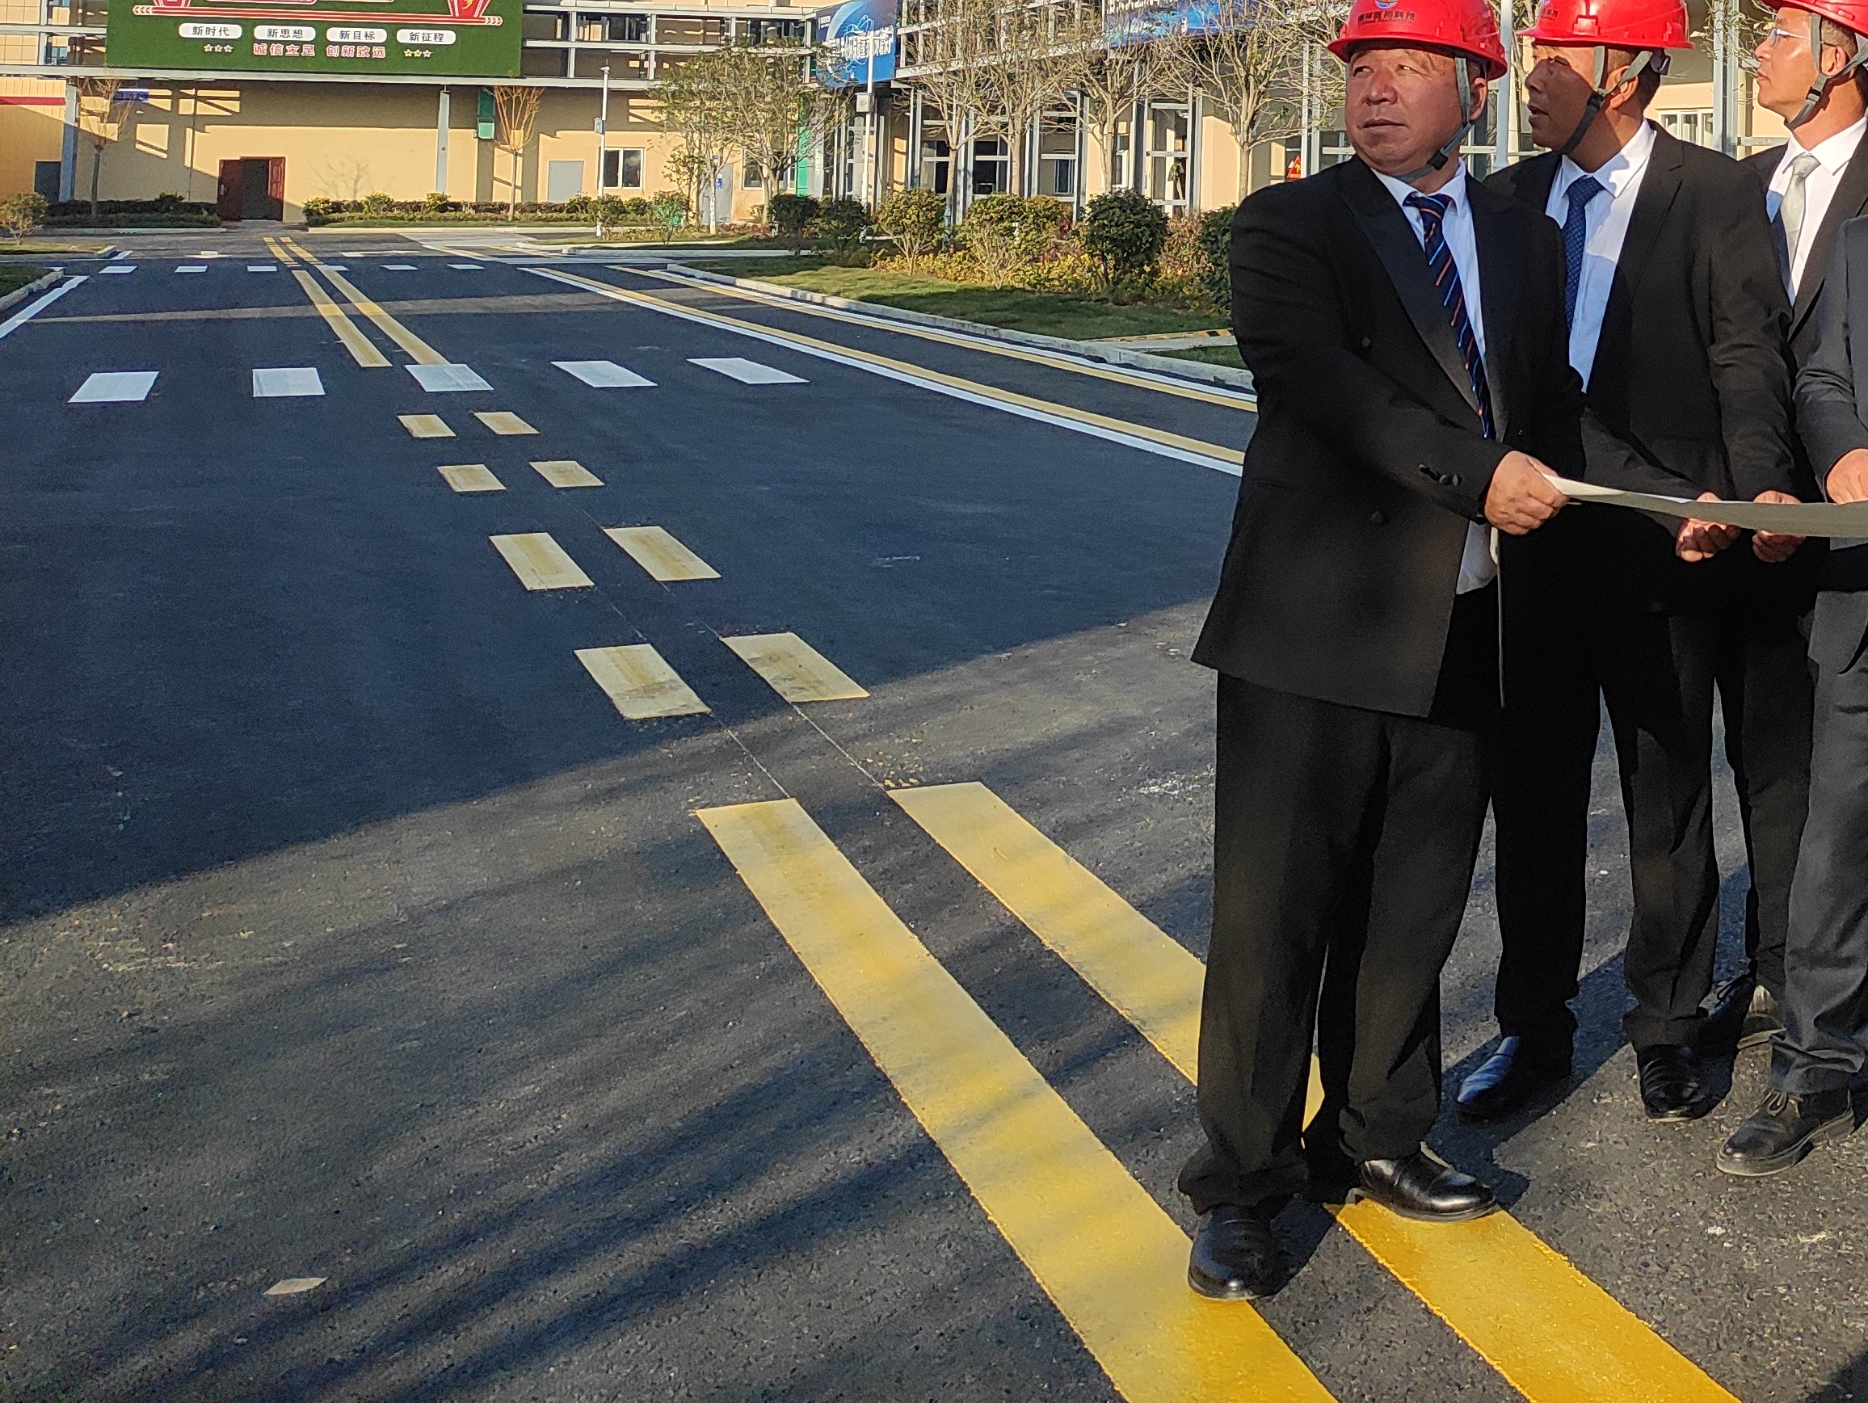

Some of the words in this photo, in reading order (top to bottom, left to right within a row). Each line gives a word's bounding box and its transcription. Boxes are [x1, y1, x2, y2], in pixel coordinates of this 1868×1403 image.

[192, 25, 230, 37] 新时代
[266, 27, 304, 39] 新思想
[338, 29, 376, 41] 新目标
[408, 31, 444, 43] 新征程
[253, 43, 316, 57] 诚信立足
[326, 45, 386, 59] 创新致远
